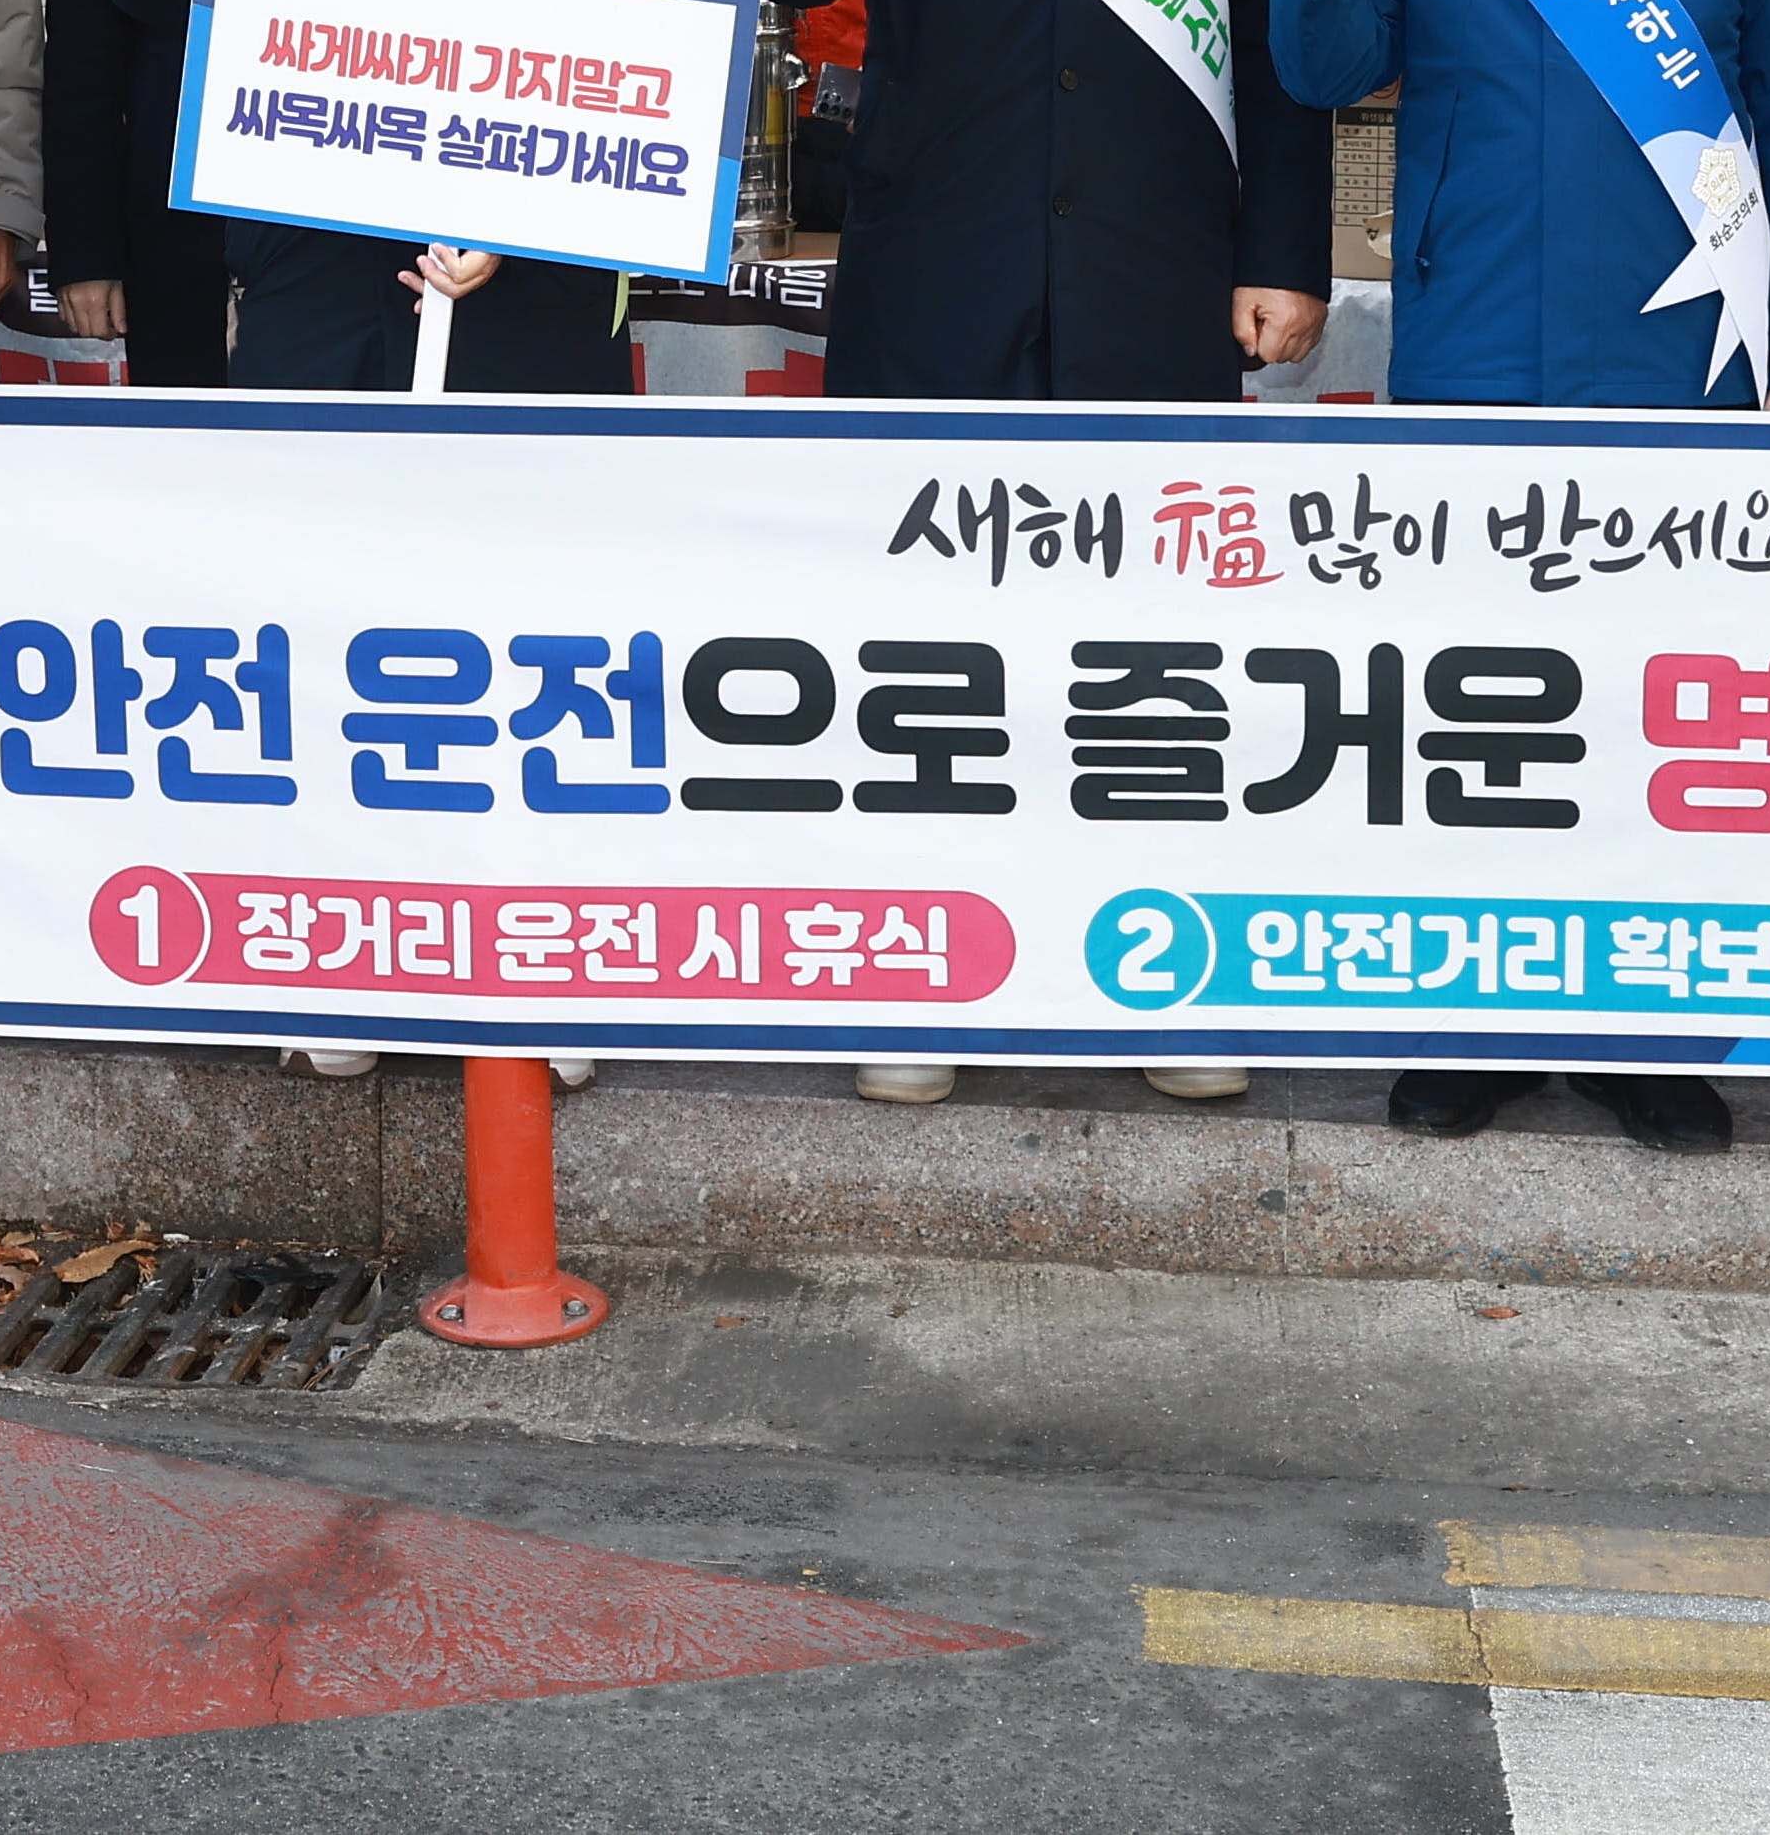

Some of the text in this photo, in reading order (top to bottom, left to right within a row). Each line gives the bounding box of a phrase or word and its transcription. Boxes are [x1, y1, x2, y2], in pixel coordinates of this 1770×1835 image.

[259, 17, 672, 120] 싸게싸게 가지말고
[226, 86, 689, 197] 싸목싸목 살펴가세요
[1709, 187, 1760, 252] 화순군의회
[887, 475, 1123, 588] 새해
[1154, 480, 1282, 588] 福
[1290, 472, 1448, 592] 많이
[341, 627, 1017, 816] 운전으로
[1064, 640, 1587, 829] 즐거운
[237, 890, 472, 981] 장거리
[494, 900, 661, 983] 운전
[678, 902, 762, 986] 시
[783, 900, 949, 988] 휴식
[1247, 909, 1585, 996] 안전거리
